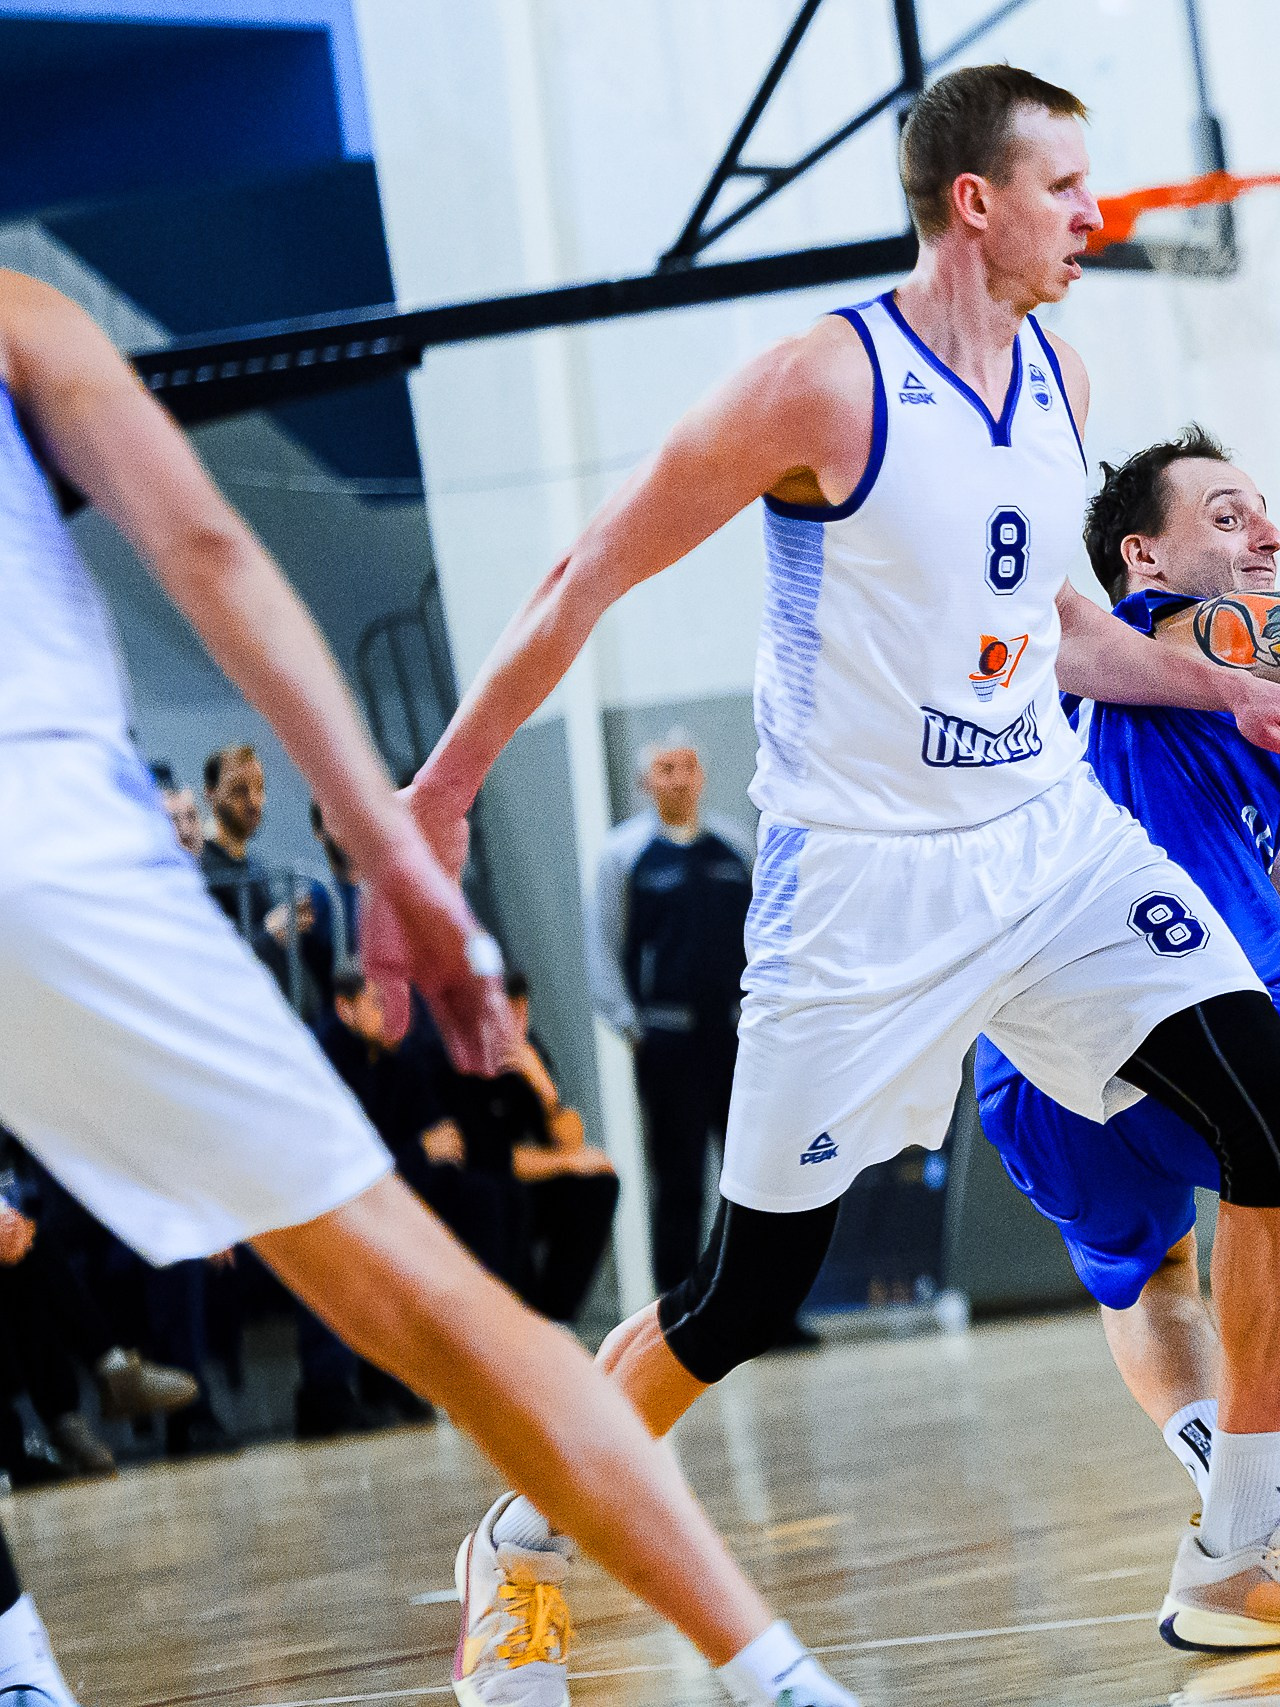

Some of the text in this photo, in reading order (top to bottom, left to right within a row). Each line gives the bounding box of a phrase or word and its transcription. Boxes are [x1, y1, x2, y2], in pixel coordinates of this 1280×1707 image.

[899, 392, 937, 405] PEAK
[984, 505, 1030, 595] 8
[1127, 890, 1210, 958] 8
[800, 1145, 839, 1165] PEAK
